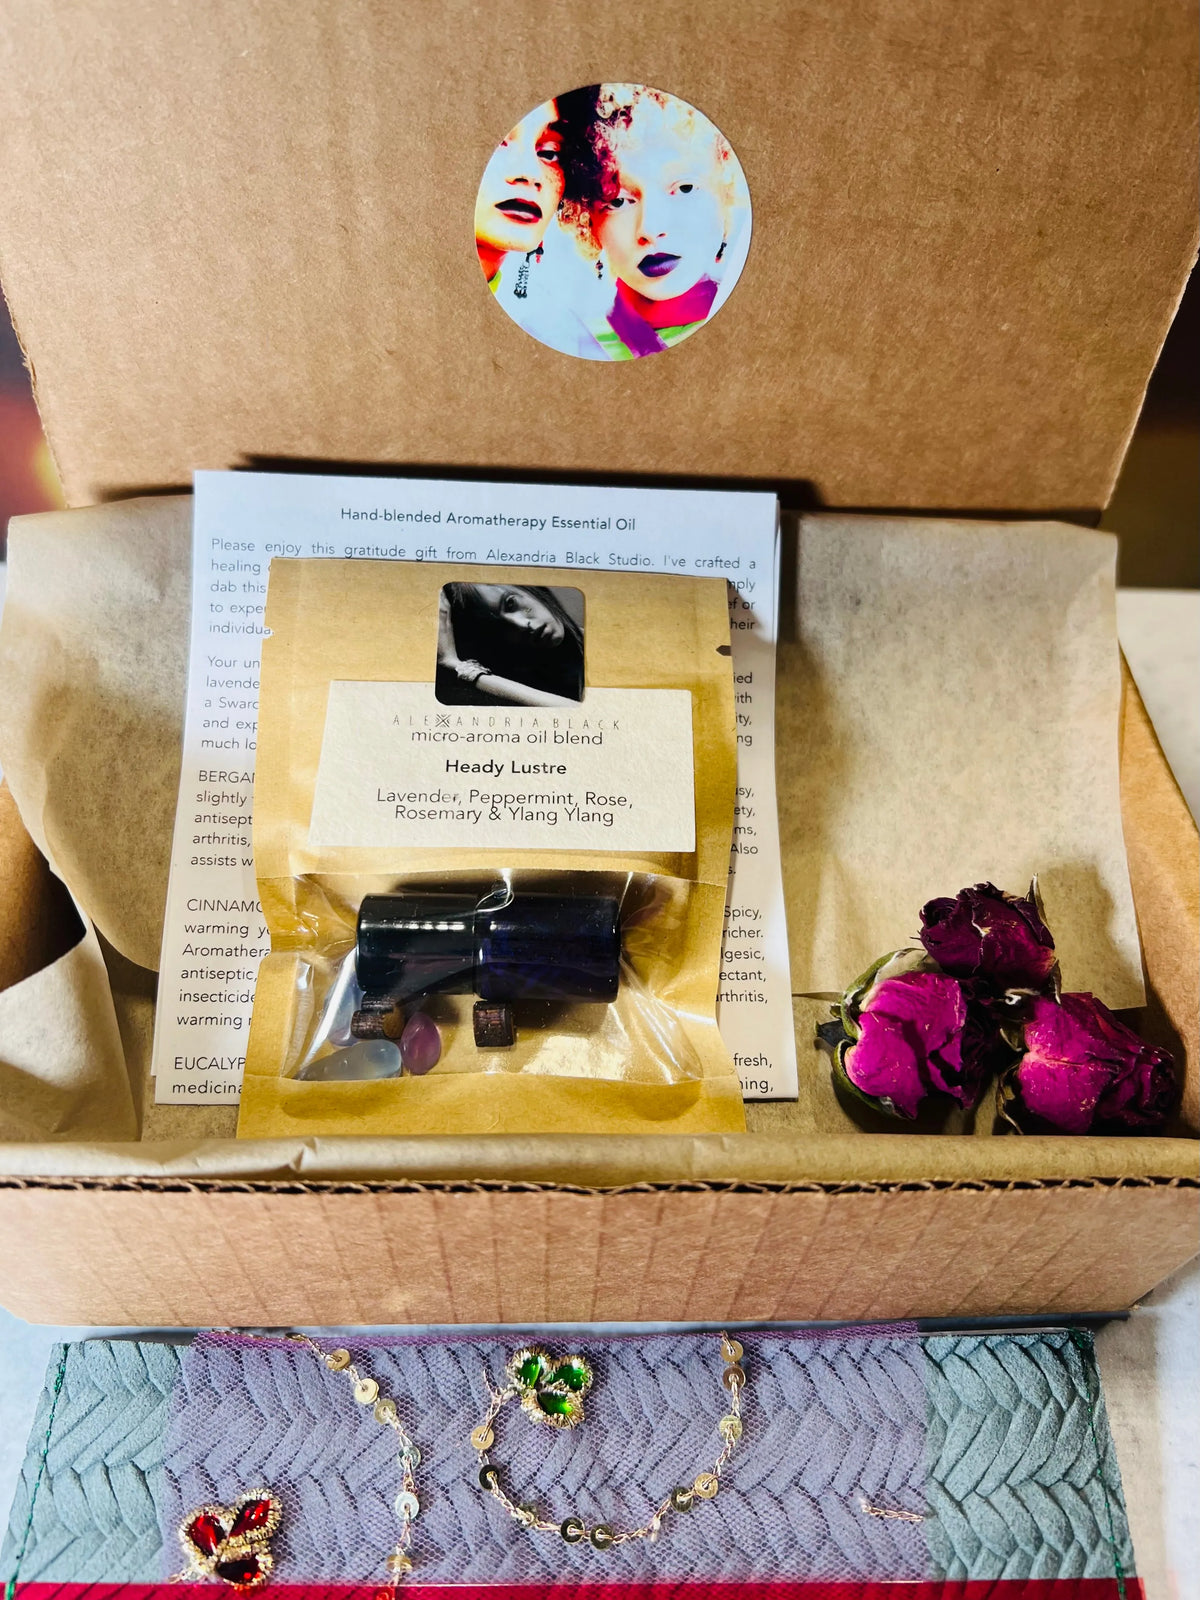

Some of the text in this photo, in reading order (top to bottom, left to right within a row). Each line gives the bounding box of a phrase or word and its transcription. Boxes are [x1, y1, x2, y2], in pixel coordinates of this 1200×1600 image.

[340, 507, 636, 532] Hand-blended Aromatherapy Essential Oil
[211, 538, 756, 570] Please enjoy this gratitude gift from Alexandria Black Studio. I've crafted a
[211, 560, 261, 576] healing
[210, 580, 267, 595] dab this
[209, 603, 224, 614] to
[741, 601, 756, 611] or
[209, 622, 275, 636] individua
[730, 618, 756, 631] heir
[207, 655, 238, 669] Your
[206, 676, 260, 690] lavende
[204, 699, 212, 708] a
[202, 717, 230, 730] and
[553, 718, 621, 731] BLACK
[201, 737, 240, 750] much
[411, 729, 603, 746] micro-aroma oil blend
[445, 758, 567, 778] Heady Lustre
[196, 791, 247, 808] slightly
[377, 788, 634, 809] Lavender, Peppermint, Rose,
[194, 812, 253, 829] antisept
[395, 805, 615, 827] Rosemary & Ylang Ylang
[192, 832, 251, 848] arthritis,
[730, 843, 759, 855] Also
[190, 854, 237, 867] assists
[724, 905, 762, 921] Spicy,
[184, 923, 249, 939] warming
[182, 943, 271, 959] Aromathera
[720, 947, 765, 963] lgesic,
[180, 967, 258, 985] antiseptic,
[719, 970, 767, 983] ectant,
[176, 1012, 243, 1030] warming
[174, 1056, 247, 1072] EUCALYP
[733, 1052, 772, 1068] fresh,
[172, 1080, 243, 1095] medicina
